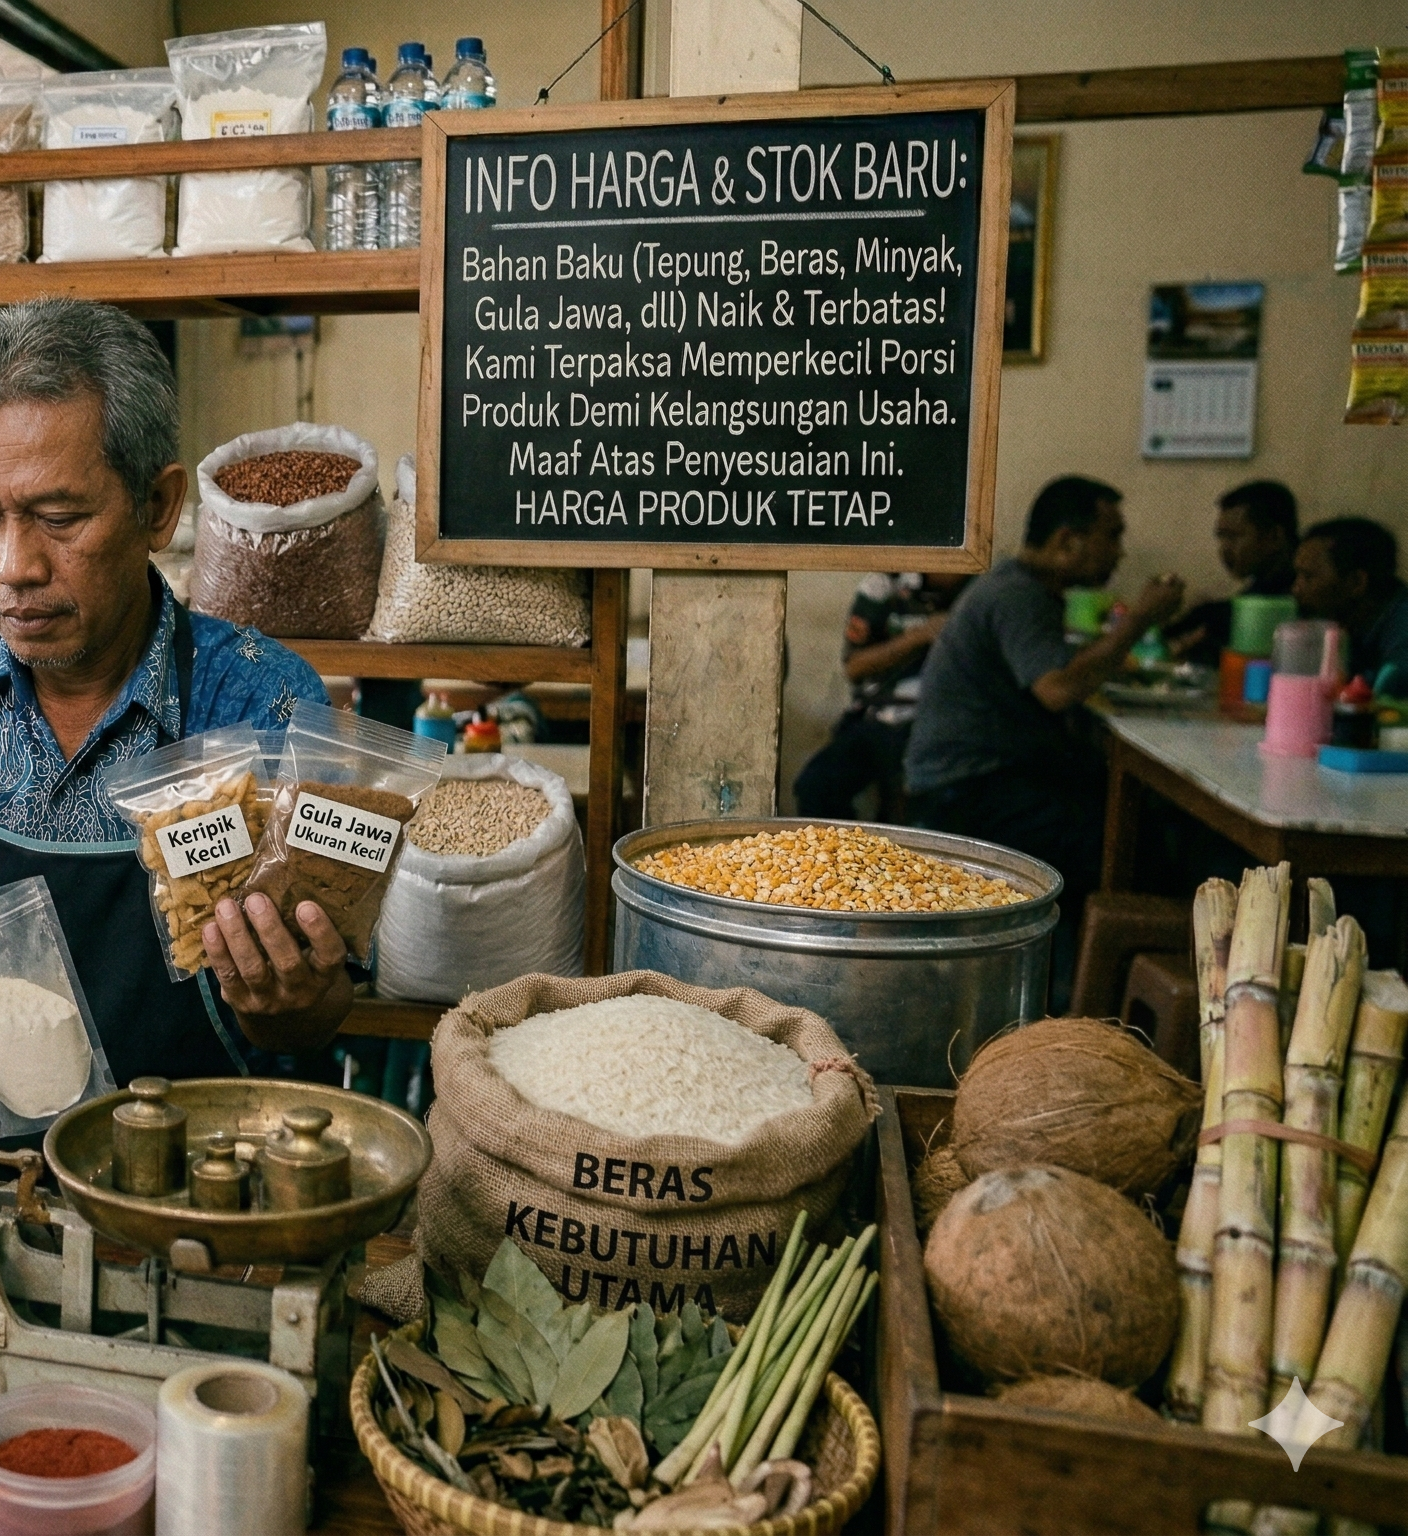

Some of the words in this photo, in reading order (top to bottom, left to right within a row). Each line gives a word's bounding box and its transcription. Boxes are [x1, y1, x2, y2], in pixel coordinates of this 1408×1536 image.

[464, 153, 558, 214] INFO
[570, 147, 701, 209] HARGA
[710, 156, 736, 205] &
[745, 142, 843, 204] STOK
[852, 139, 969, 200] BARU:
[462, 246, 548, 283] Bahan
[555, 244, 623, 281] Baku
[632, 242, 751, 287] (Tepung,
[759, 239, 846, 279] Beras,
[854, 234, 963, 283] Minyak,
[474, 294, 540, 331] Gula
[547, 294, 632, 334] Jawa,
[640, 291, 688, 333] dll)
[697, 290, 763, 327] Naik
[771, 291, 795, 325] &
[803, 287, 946, 326] Terbatas!
[464, 344, 536, 380] Kami
[543, 344, 672, 387] Terpaksa
[679, 339, 872, 384] Memperkecil
[880, 338, 957, 375] Porsi
[462, 391, 561, 428] Produk
[569, 392, 641, 427] Demi
[649, 393, 848, 435] Kelangsungan
[858, 387, 957, 426] Usaha.
[509, 438, 583, 477] Maaf
[590, 441, 655, 476] Atas
[666, 441, 849, 485] Penyesuaian
[861, 441, 904, 477] Ini.
[515, 490, 629, 526] HARGA
[637, 490, 777, 526] PRODUK
[786, 489, 895, 527] TETAP.
[167, 814, 236, 848] Keripik
[294, 824, 346, 851] Ukuran
[349, 842, 386, 862] Kecil
[299, 802, 343, 829] Gula
[345, 816, 393, 844] Jawa
[185, 838, 232, 866] Kecil
[573, 1152, 713, 1202] BERAS
[504, 1201, 777, 1270] KEBUTUHAN
[560, 1265, 717, 1317] UTAMA
